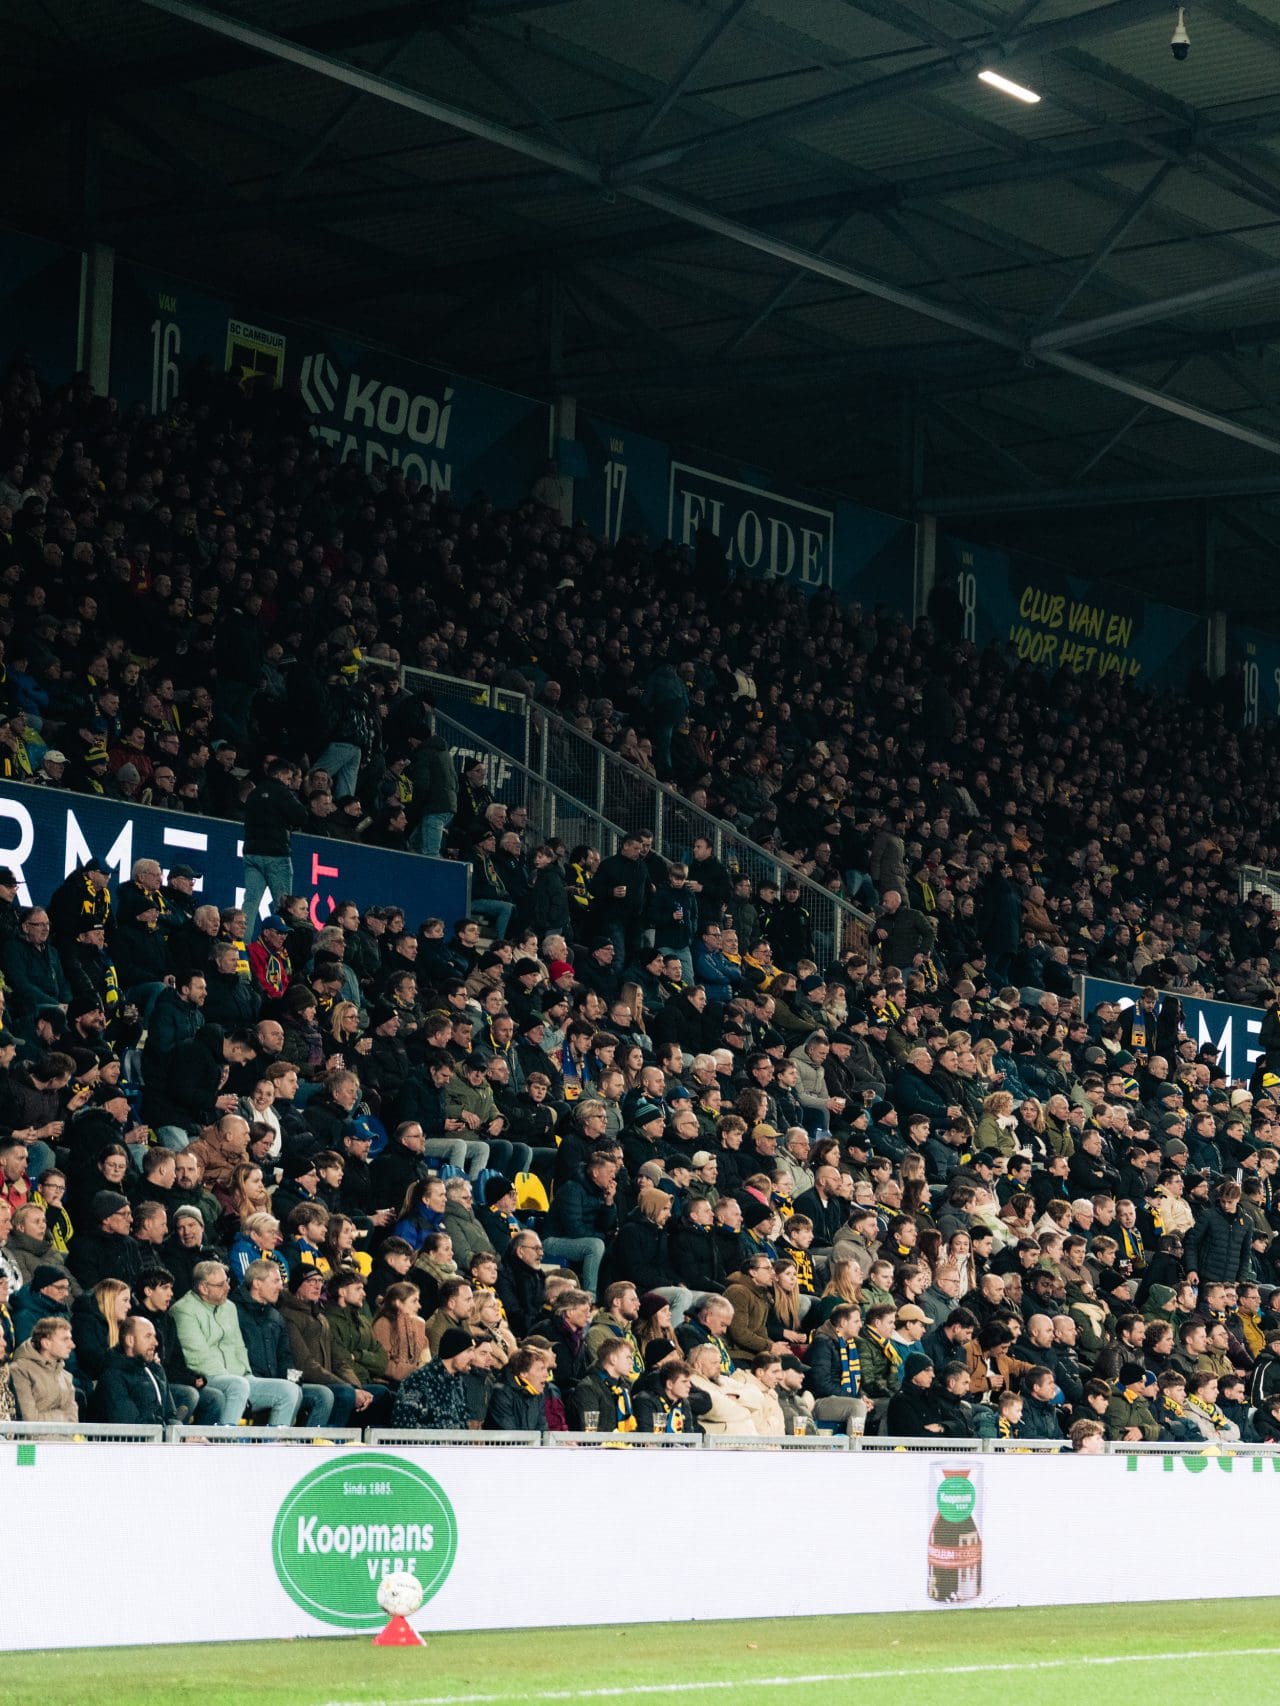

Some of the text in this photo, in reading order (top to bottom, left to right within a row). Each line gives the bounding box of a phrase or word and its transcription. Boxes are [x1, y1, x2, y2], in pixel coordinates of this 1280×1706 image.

[158, 292, 176, 313] VAK
[230, 322, 284, 348] SC CAMBUUR
[150, 319, 181, 416] 16
[604, 461, 628, 547] 17
[1019, 585, 1133, 649] CLUB VAN EN
[1059, 639, 1098, 674] HET
[342, 1481, 367, 1496] Sinds
[297, 1515, 435, 1560] Koopmans
